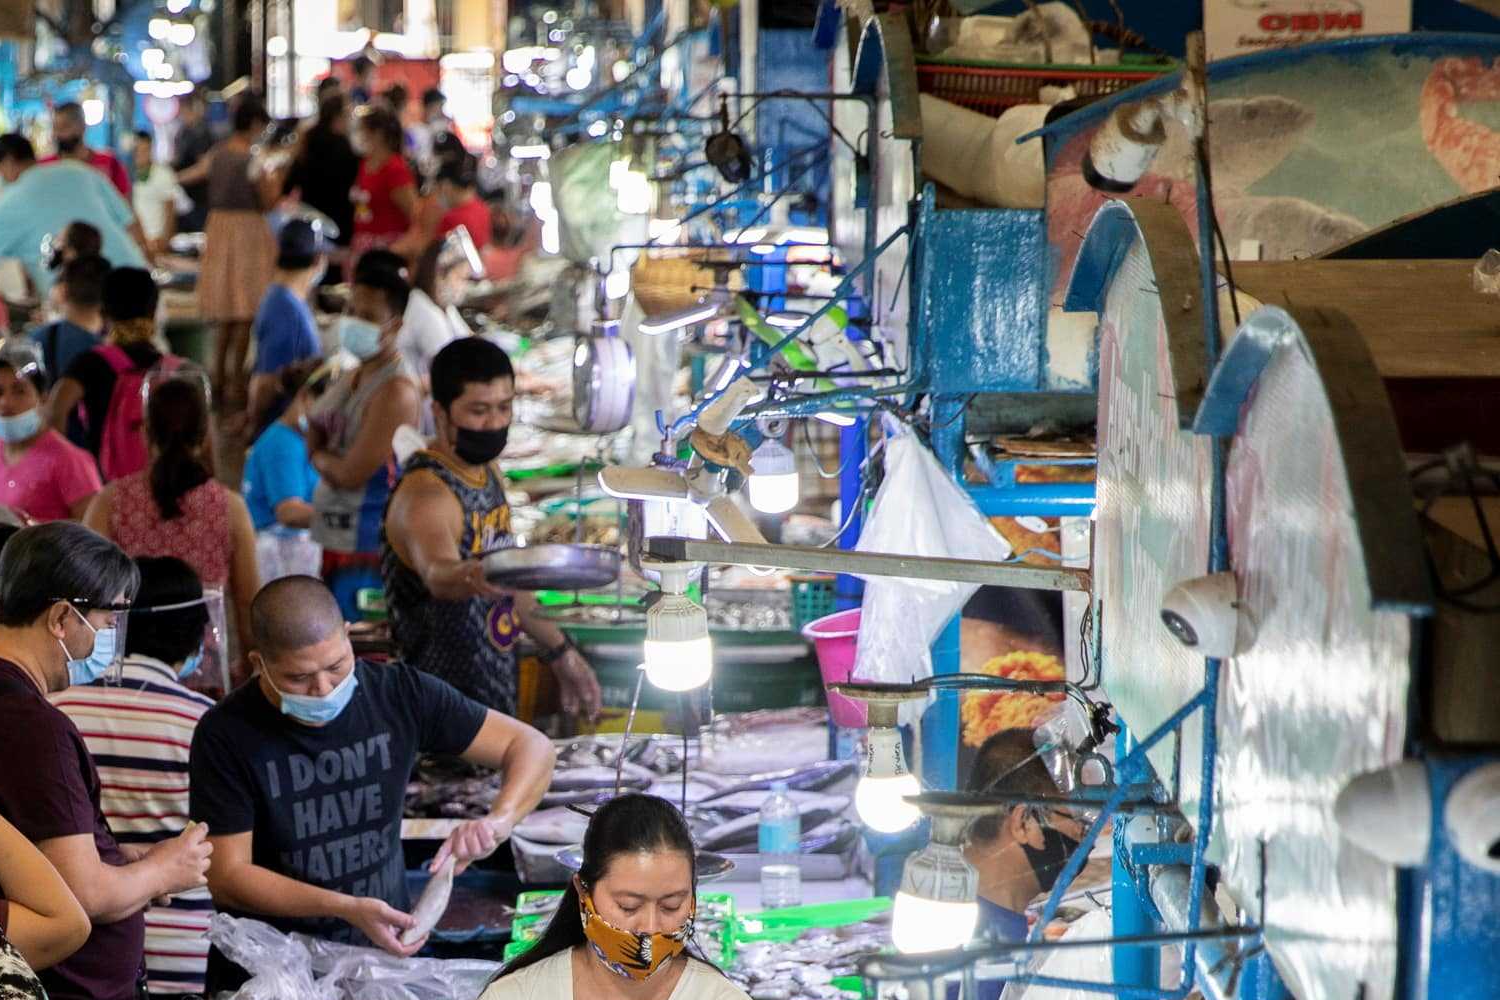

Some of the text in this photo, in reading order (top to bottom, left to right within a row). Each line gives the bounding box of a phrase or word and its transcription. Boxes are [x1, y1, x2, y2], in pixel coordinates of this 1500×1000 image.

[1258, 11, 1363, 32] CBM
[266, 732, 392, 799] I DON'T
[293, 783, 383, 840] HAVE
